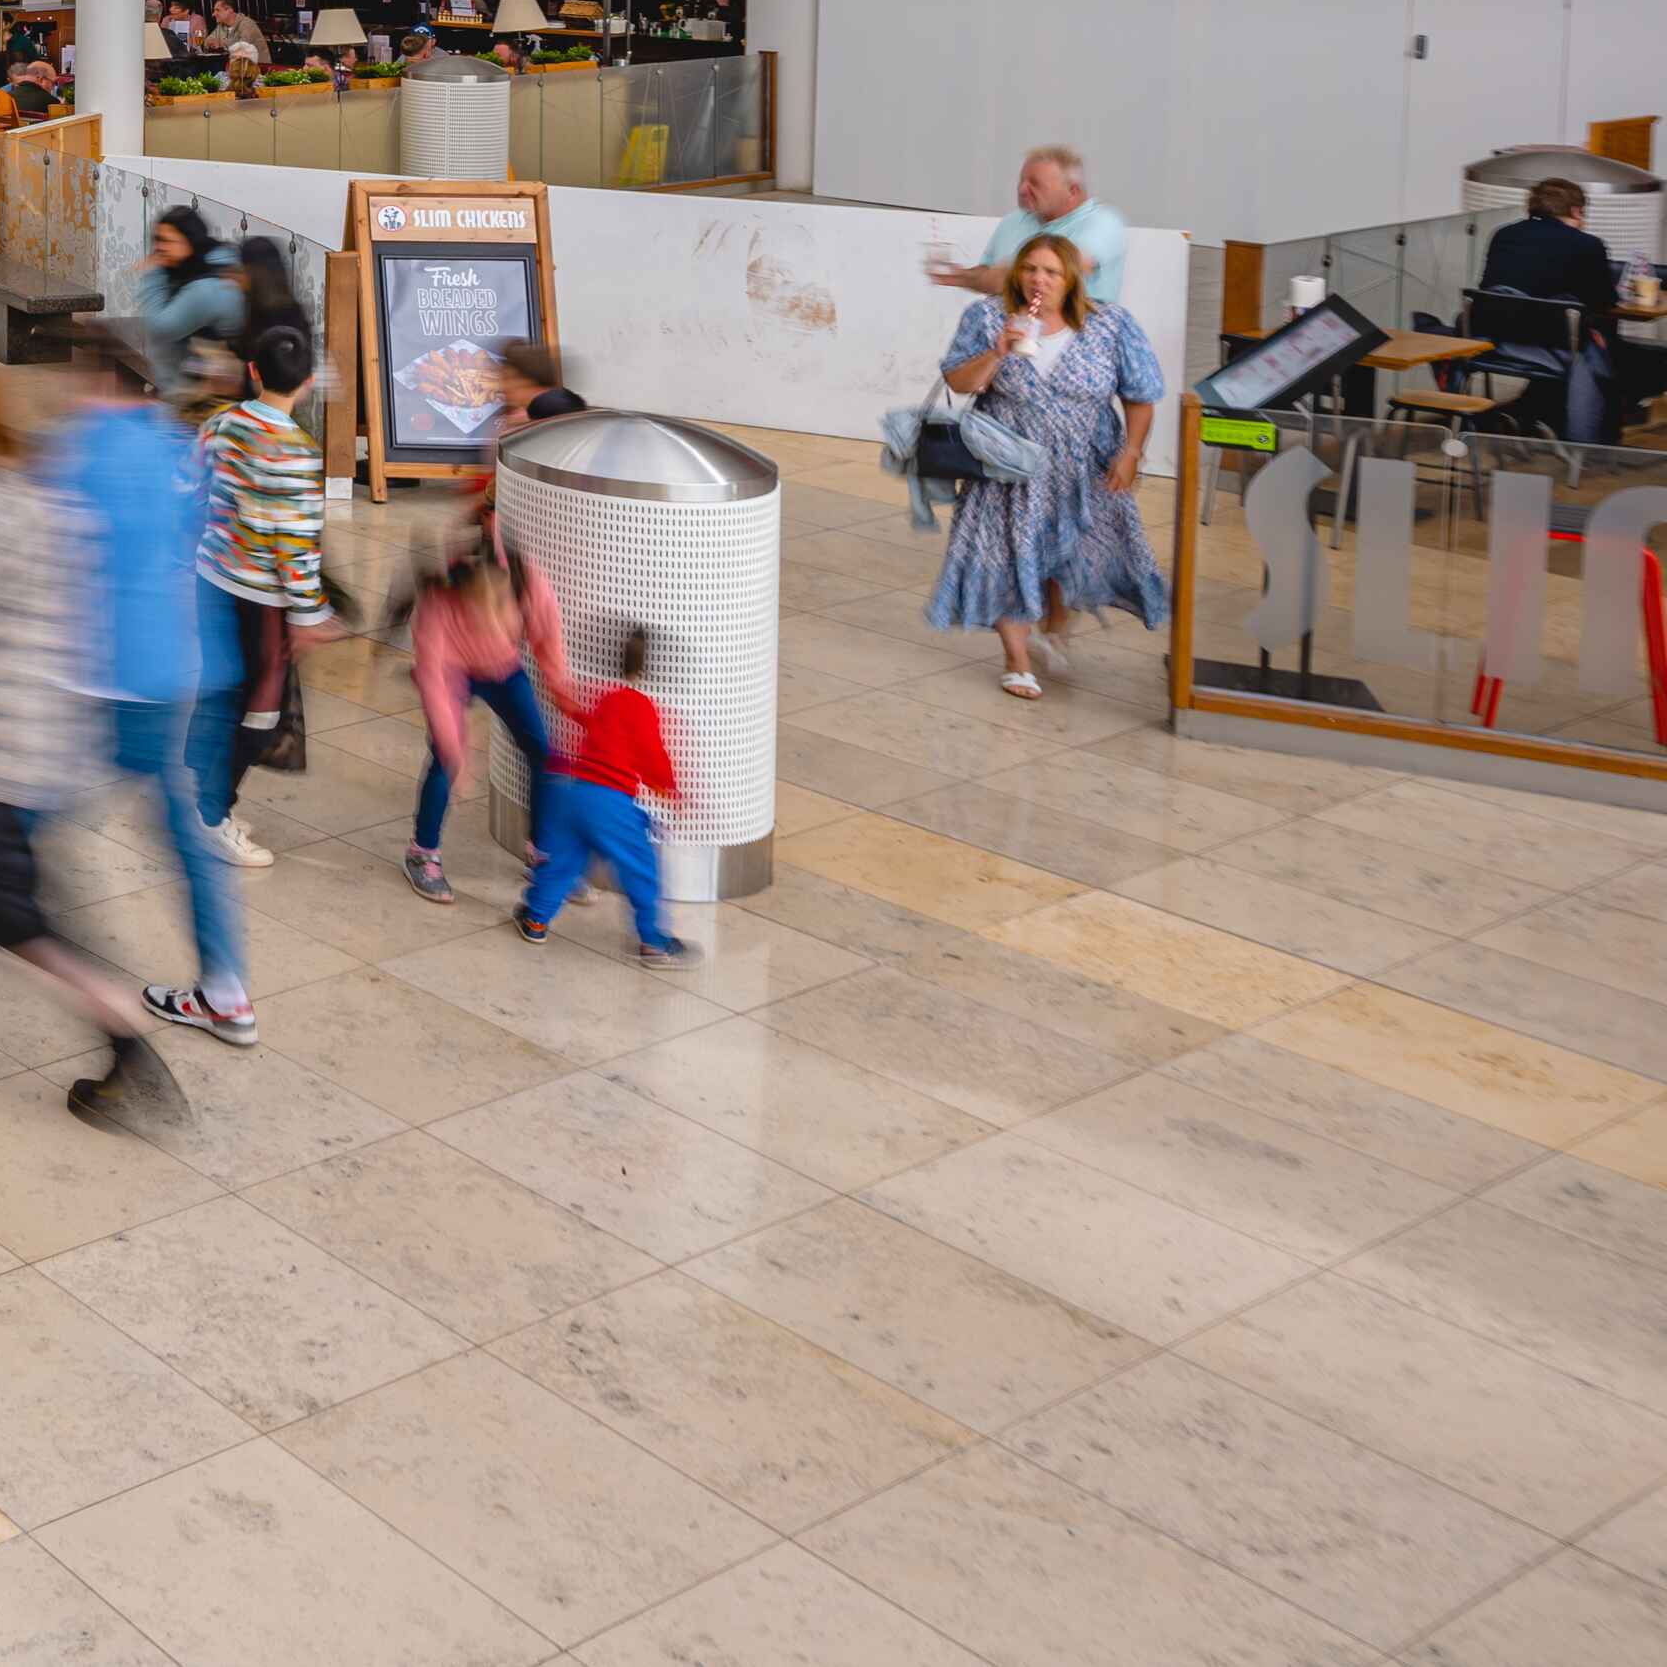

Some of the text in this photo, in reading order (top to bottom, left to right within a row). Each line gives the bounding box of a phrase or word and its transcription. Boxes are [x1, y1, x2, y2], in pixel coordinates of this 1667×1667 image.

[412, 208, 526, 229] SLIM CHICKENS
[423, 266, 482, 287] Fresh
[418, 287, 498, 309] BREADED
[419, 310, 499, 336] WINGS
